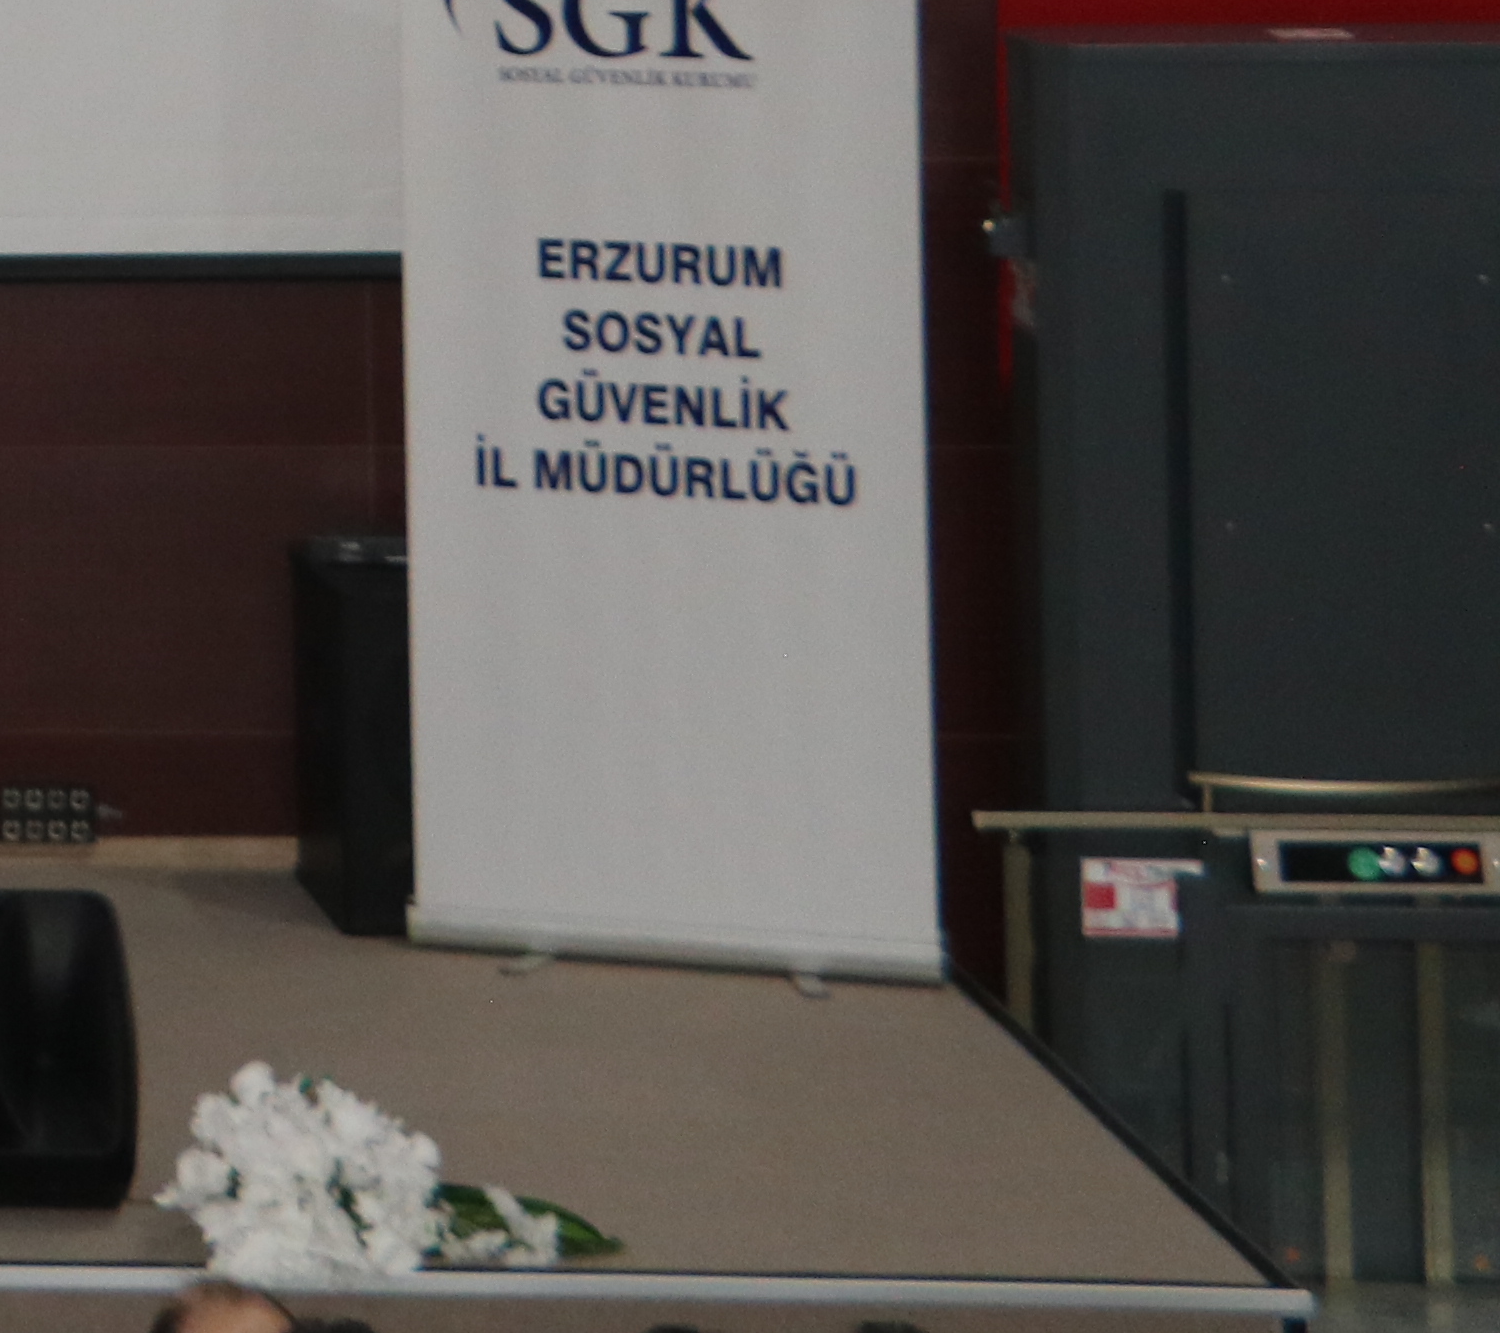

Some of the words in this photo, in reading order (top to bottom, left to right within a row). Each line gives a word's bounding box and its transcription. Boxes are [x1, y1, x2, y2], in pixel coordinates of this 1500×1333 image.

[536, 236, 785, 289] ERZURUM
[562, 307, 761, 360] SOSYAL
[536, 368, 790, 432] GÜVENLİK
[474, 432, 517, 489] İL
[533, 439, 857, 507] MÜDÜRLÜĞÜ
